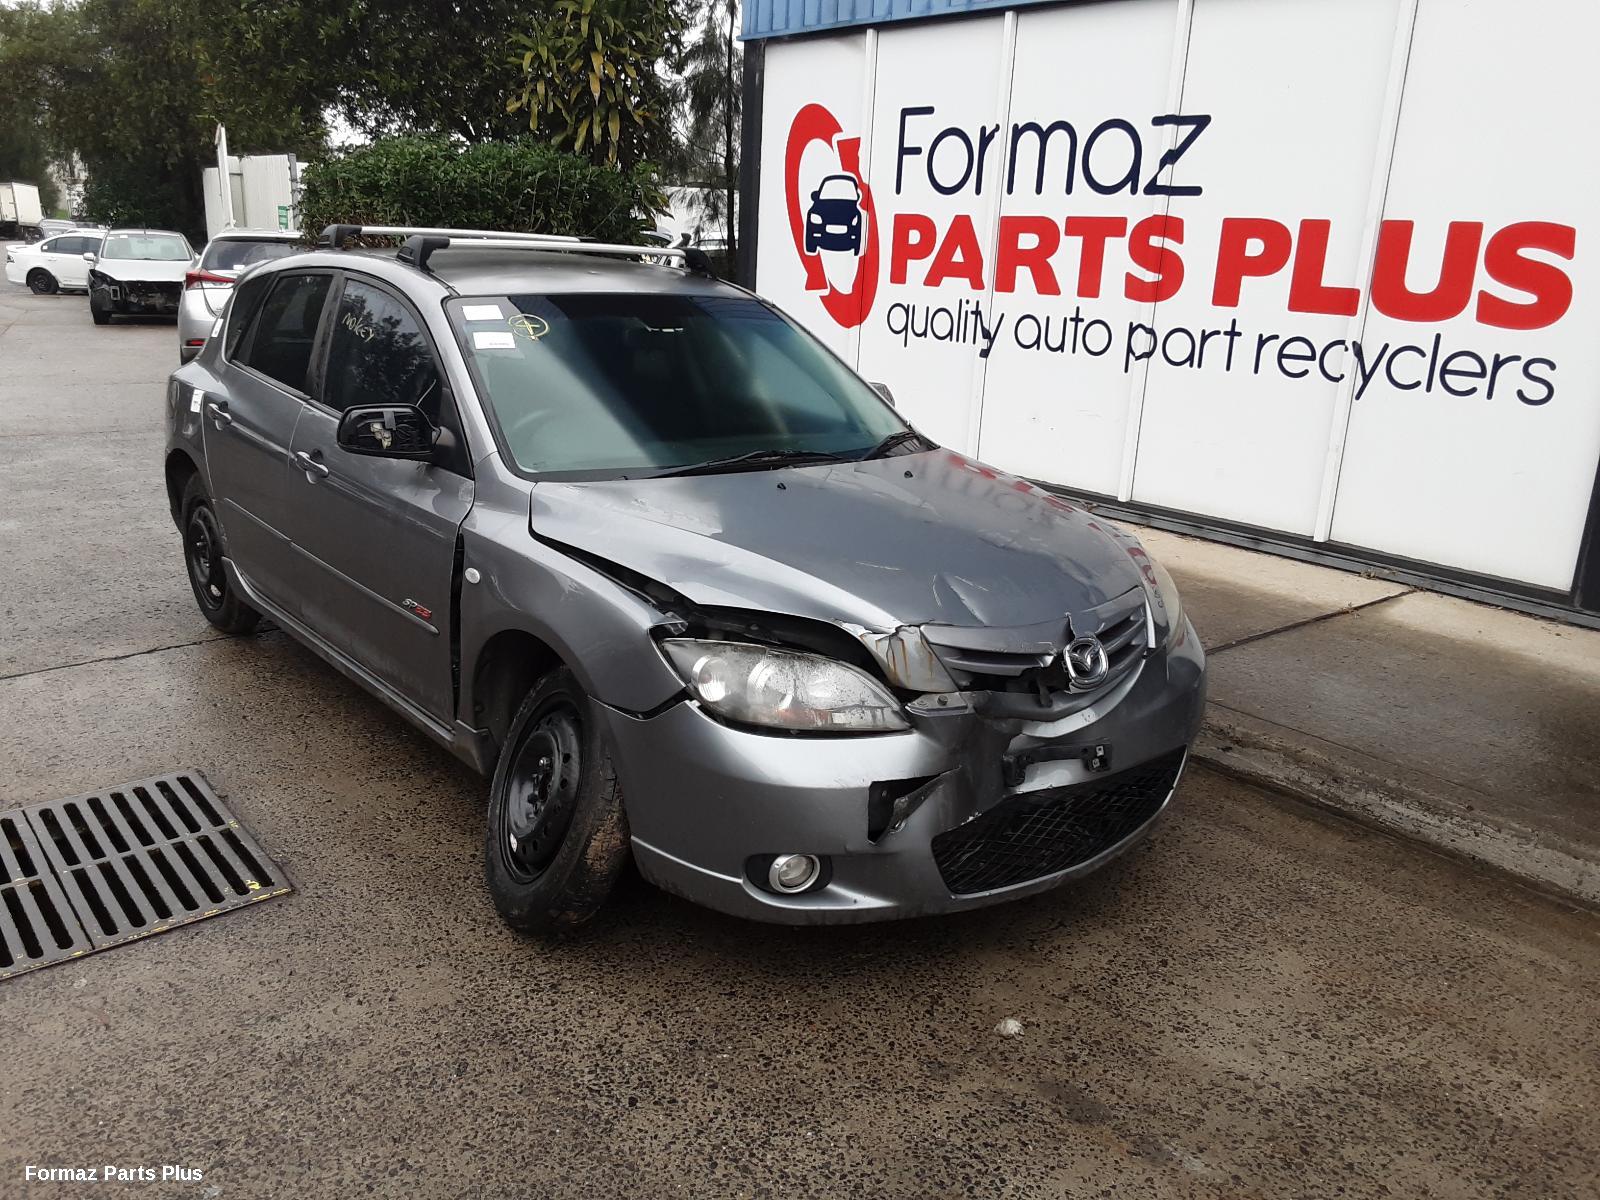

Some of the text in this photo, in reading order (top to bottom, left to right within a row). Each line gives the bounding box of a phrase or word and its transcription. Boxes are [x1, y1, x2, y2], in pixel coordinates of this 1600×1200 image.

[895, 106, 1212, 196] Formaz
[890, 213, 1577, 331] PARTS PLUS
[886, 299, 1558, 407] quality auto part recyclers
